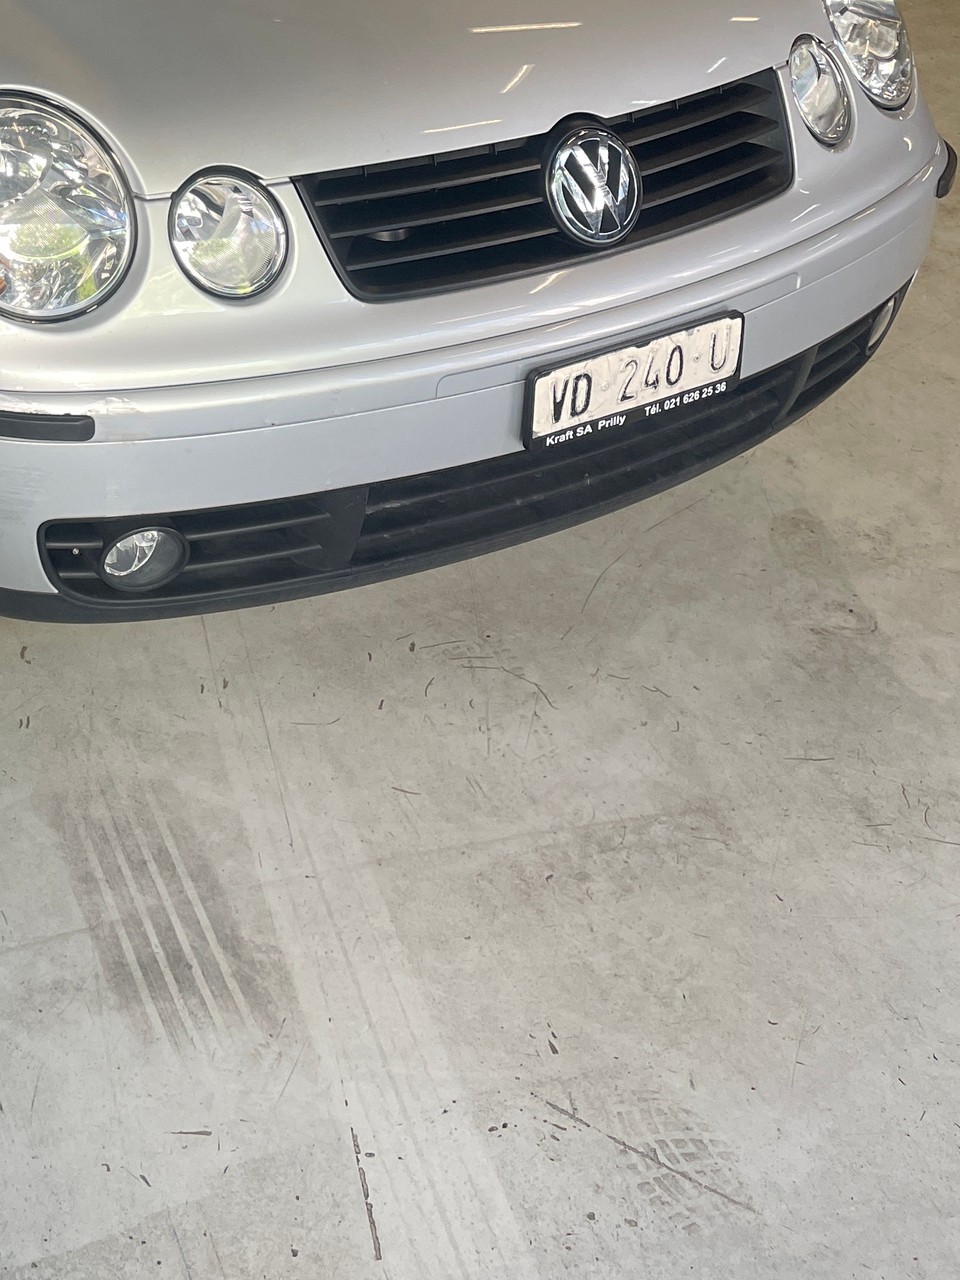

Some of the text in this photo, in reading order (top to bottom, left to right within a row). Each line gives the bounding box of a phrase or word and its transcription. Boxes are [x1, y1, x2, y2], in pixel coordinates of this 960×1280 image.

[645, 382, 727, 417] Tél. 021 626 25 36
[546, 415, 626, 446] Kraft SA Prilly
